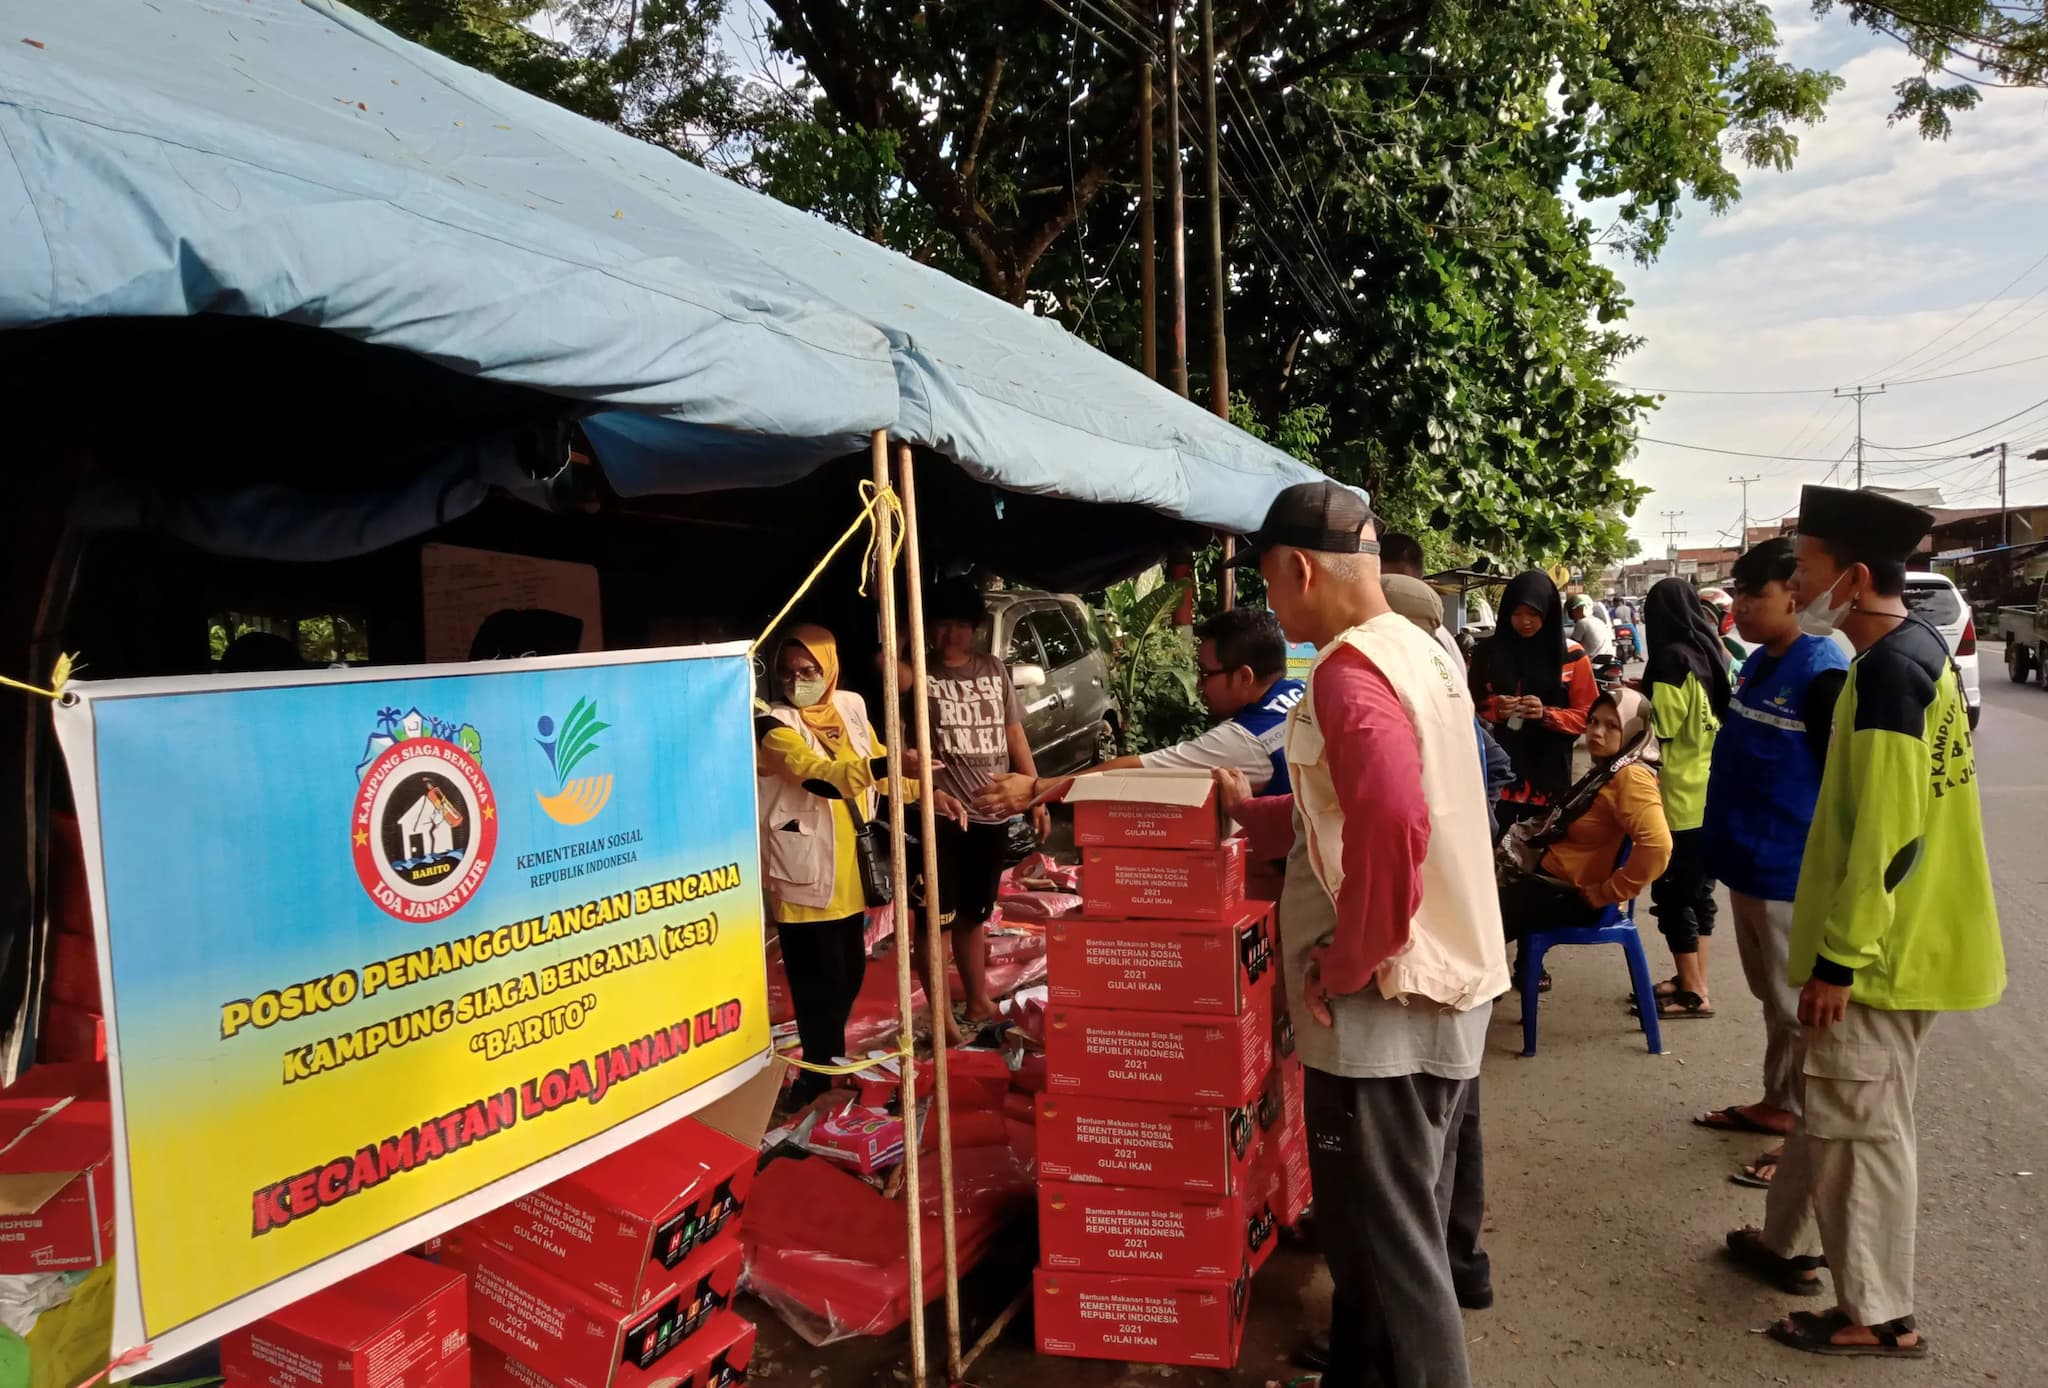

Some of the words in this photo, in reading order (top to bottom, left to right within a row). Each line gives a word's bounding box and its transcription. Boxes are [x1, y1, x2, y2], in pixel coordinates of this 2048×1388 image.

[1262, 683, 1305, 714] TAG
[358, 754, 400, 824] KAMPUNG
[402, 744, 440, 761] SIAGA
[443, 750, 488, 804] BENCANA
[1137, 820, 1155, 829] 2021
[1125, 829, 1147, 837] GULAI
[1148, 829, 1167, 838] IKAN
[516, 837, 605, 870] KEMENTERIAN
[607, 829, 643, 850] SOSIAL
[412, 864, 450, 880] BARITO
[530, 864, 584, 888] REPUBLIK
[585, 850, 637, 874] INDONESIA
[1115, 872, 1162, 880] KEMENTERIAN
[1164, 873, 1188, 881] SOSIAL
[1115, 878, 1149, 887] REPUBLIK
[1150, 880, 1188, 888] INDONESIA
[372, 881, 403, 912] LOA
[405, 891, 461, 918] JANAN
[459, 859, 487, 897] ILIR
[1144, 888, 1161, 896] 2021
[1131, 896, 1153, 904] GULAI
[1154, 897, 1173, 905] IKAN
[220, 969, 358, 1040] POSKO
[362, 891, 631, 999] PENANGGULANGAN
[634, 862, 741, 915] BENCANA
[1086, 948, 1148, 958] KEMENTERIAN
[1150, 949, 1183, 959] SOSIAL
[1087, 957, 1132, 967] REPUBLIK
[1133, 958, 1183, 968] INDONESIA
[1124, 970, 1147, 979] 2021
[1107, 981, 1136, 990] GULAI
[1138, 981, 1161, 991] IKAN
[283, 1002, 453, 1085] KAMPUNG
[456, 972, 539, 1024] SIAGA
[540, 934, 657, 995] BENCANA
[659, 911, 719, 959] (KSB)
[1086, 1036, 1149, 1048] KEMENTERIAN
[1151, 1040, 1184, 1050] SOSIAL
[1087, 1045, 1132, 1056] REPUBLIK
[1134, 1047, 1184, 1059] INDONESIA
[1124, 1059, 1147, 1069] 2021
[1108, 1070, 1137, 1080] GULAI
[1139, 1071, 1162, 1081] IKAN
[251, 1088, 516, 1237] KECAMATAN
[520, 1060, 591, 1121] LOA
[590, 1018, 691, 1104] JANAN
[693, 998, 742, 1048] ILIR
[1077, 1125, 1139, 1136] KEMENTERIAN
[1141, 1130, 1174, 1140] SOSIAL
[1077, 1134, 1122, 1145] REPUBLIK
[1123, 1137, 1174, 1149] INDONESIA
[1114, 1149, 1137, 1158] 2021
[1098, 1159, 1127, 1169] GULAI
[1129, 1161, 1152, 1171] IKAN
[514, 1200, 543, 1218] UBLIK
[543, 1214, 592, 1243] INDONESIA
[562, 1213, 595, 1234] SOSIAL
[1086, 1216, 1149, 1227] KEMENTERIAN
[1151, 1219, 1185, 1229] SOSIAL
[531, 1221, 554, 1238] 2021
[1086, 1225, 1132, 1236] REPUBLIK
[1134, 1227, 1185, 1238] INDONESIA
[513, 1225, 542, 1244] GULAI
[543, 1239, 567, 1258] IKAN
[1124, 1239, 1147, 1248] 2021
[1108, 1249, 1138, 1259] GULAI
[1139, 1251, 1163, 1260] IKAN
[476, 1272, 534, 1311] KEMENTERIAN
[535, 1306, 565, 1331] SOSIAL
[1080, 1301, 1143, 1312] KEMENTERIAN
[1145, 1305, 1178, 1315] SOSIAL
[475, 1281, 516, 1311] REPUBLIK
[517, 1305, 563, 1340] INDONESIA
[1080, 1310, 1126, 1321] REPUBLIK
[1128, 1313, 1178, 1324] INDONESIA
[506, 1313, 528, 1332] 2021
[1119, 1324, 1142, 1333] 2021
[489, 1316, 516, 1337] GULAI
[517, 1333, 539, 1351] IKAN
[1103, 1335, 1132, 1345] GULAI
[1134, 1336, 1157, 1346] IKAN
